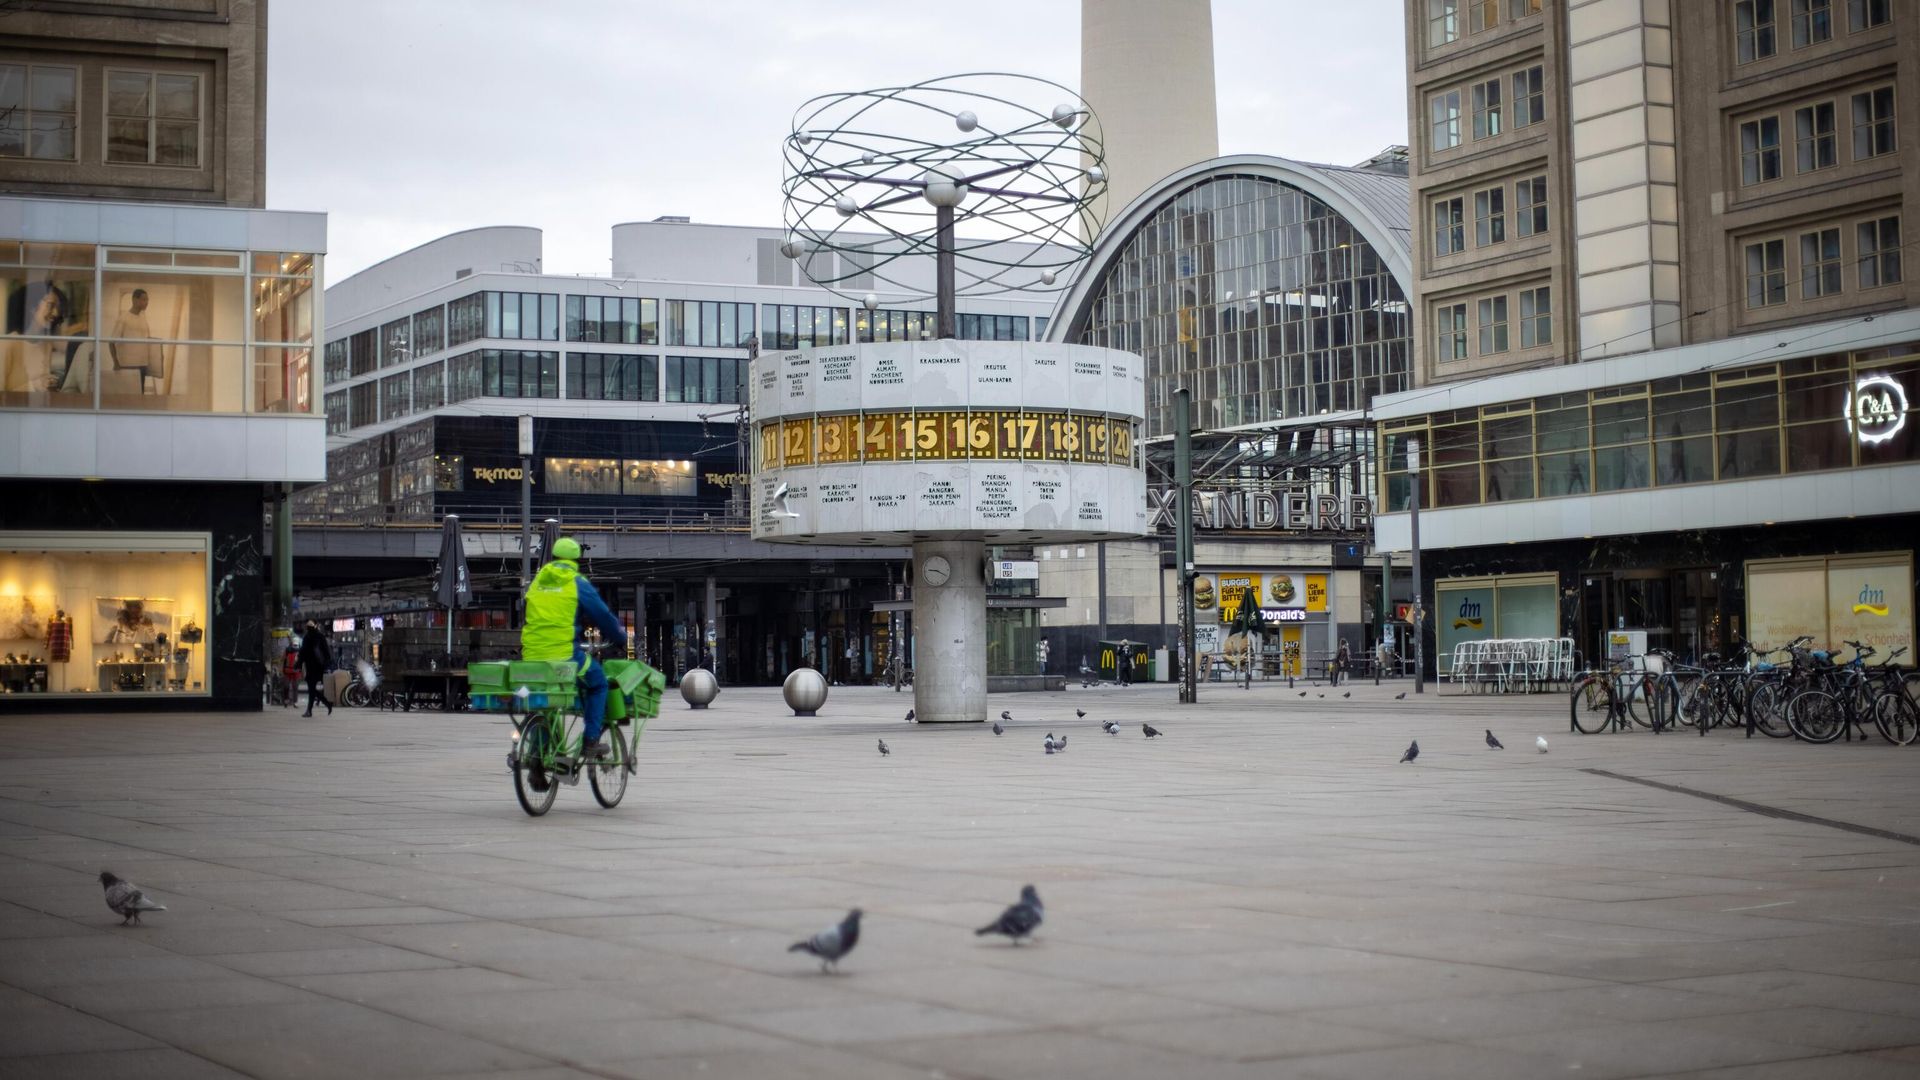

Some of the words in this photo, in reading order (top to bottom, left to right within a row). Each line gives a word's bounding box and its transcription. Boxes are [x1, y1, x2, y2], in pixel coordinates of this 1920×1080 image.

[1857, 392, 1898, 424] C&A
[783, 427, 804, 457] 12
[813, 423, 842, 453] 13
[852, 421, 887, 450] 14
[901, 419, 938, 450] 15
[952, 418, 991, 449] 16
[1003, 419, 1039, 449] 17
[1050, 421, 1079, 451] 18
[1087, 423, 1107, 453] 19
[1113, 427, 1130, 458] 20
[1221, 579, 1251, 587] BURGER
[1221, 586, 1235, 595] FÜR
[1859, 584, 1884, 604] dm
[1459, 597, 1481, 618] dm
